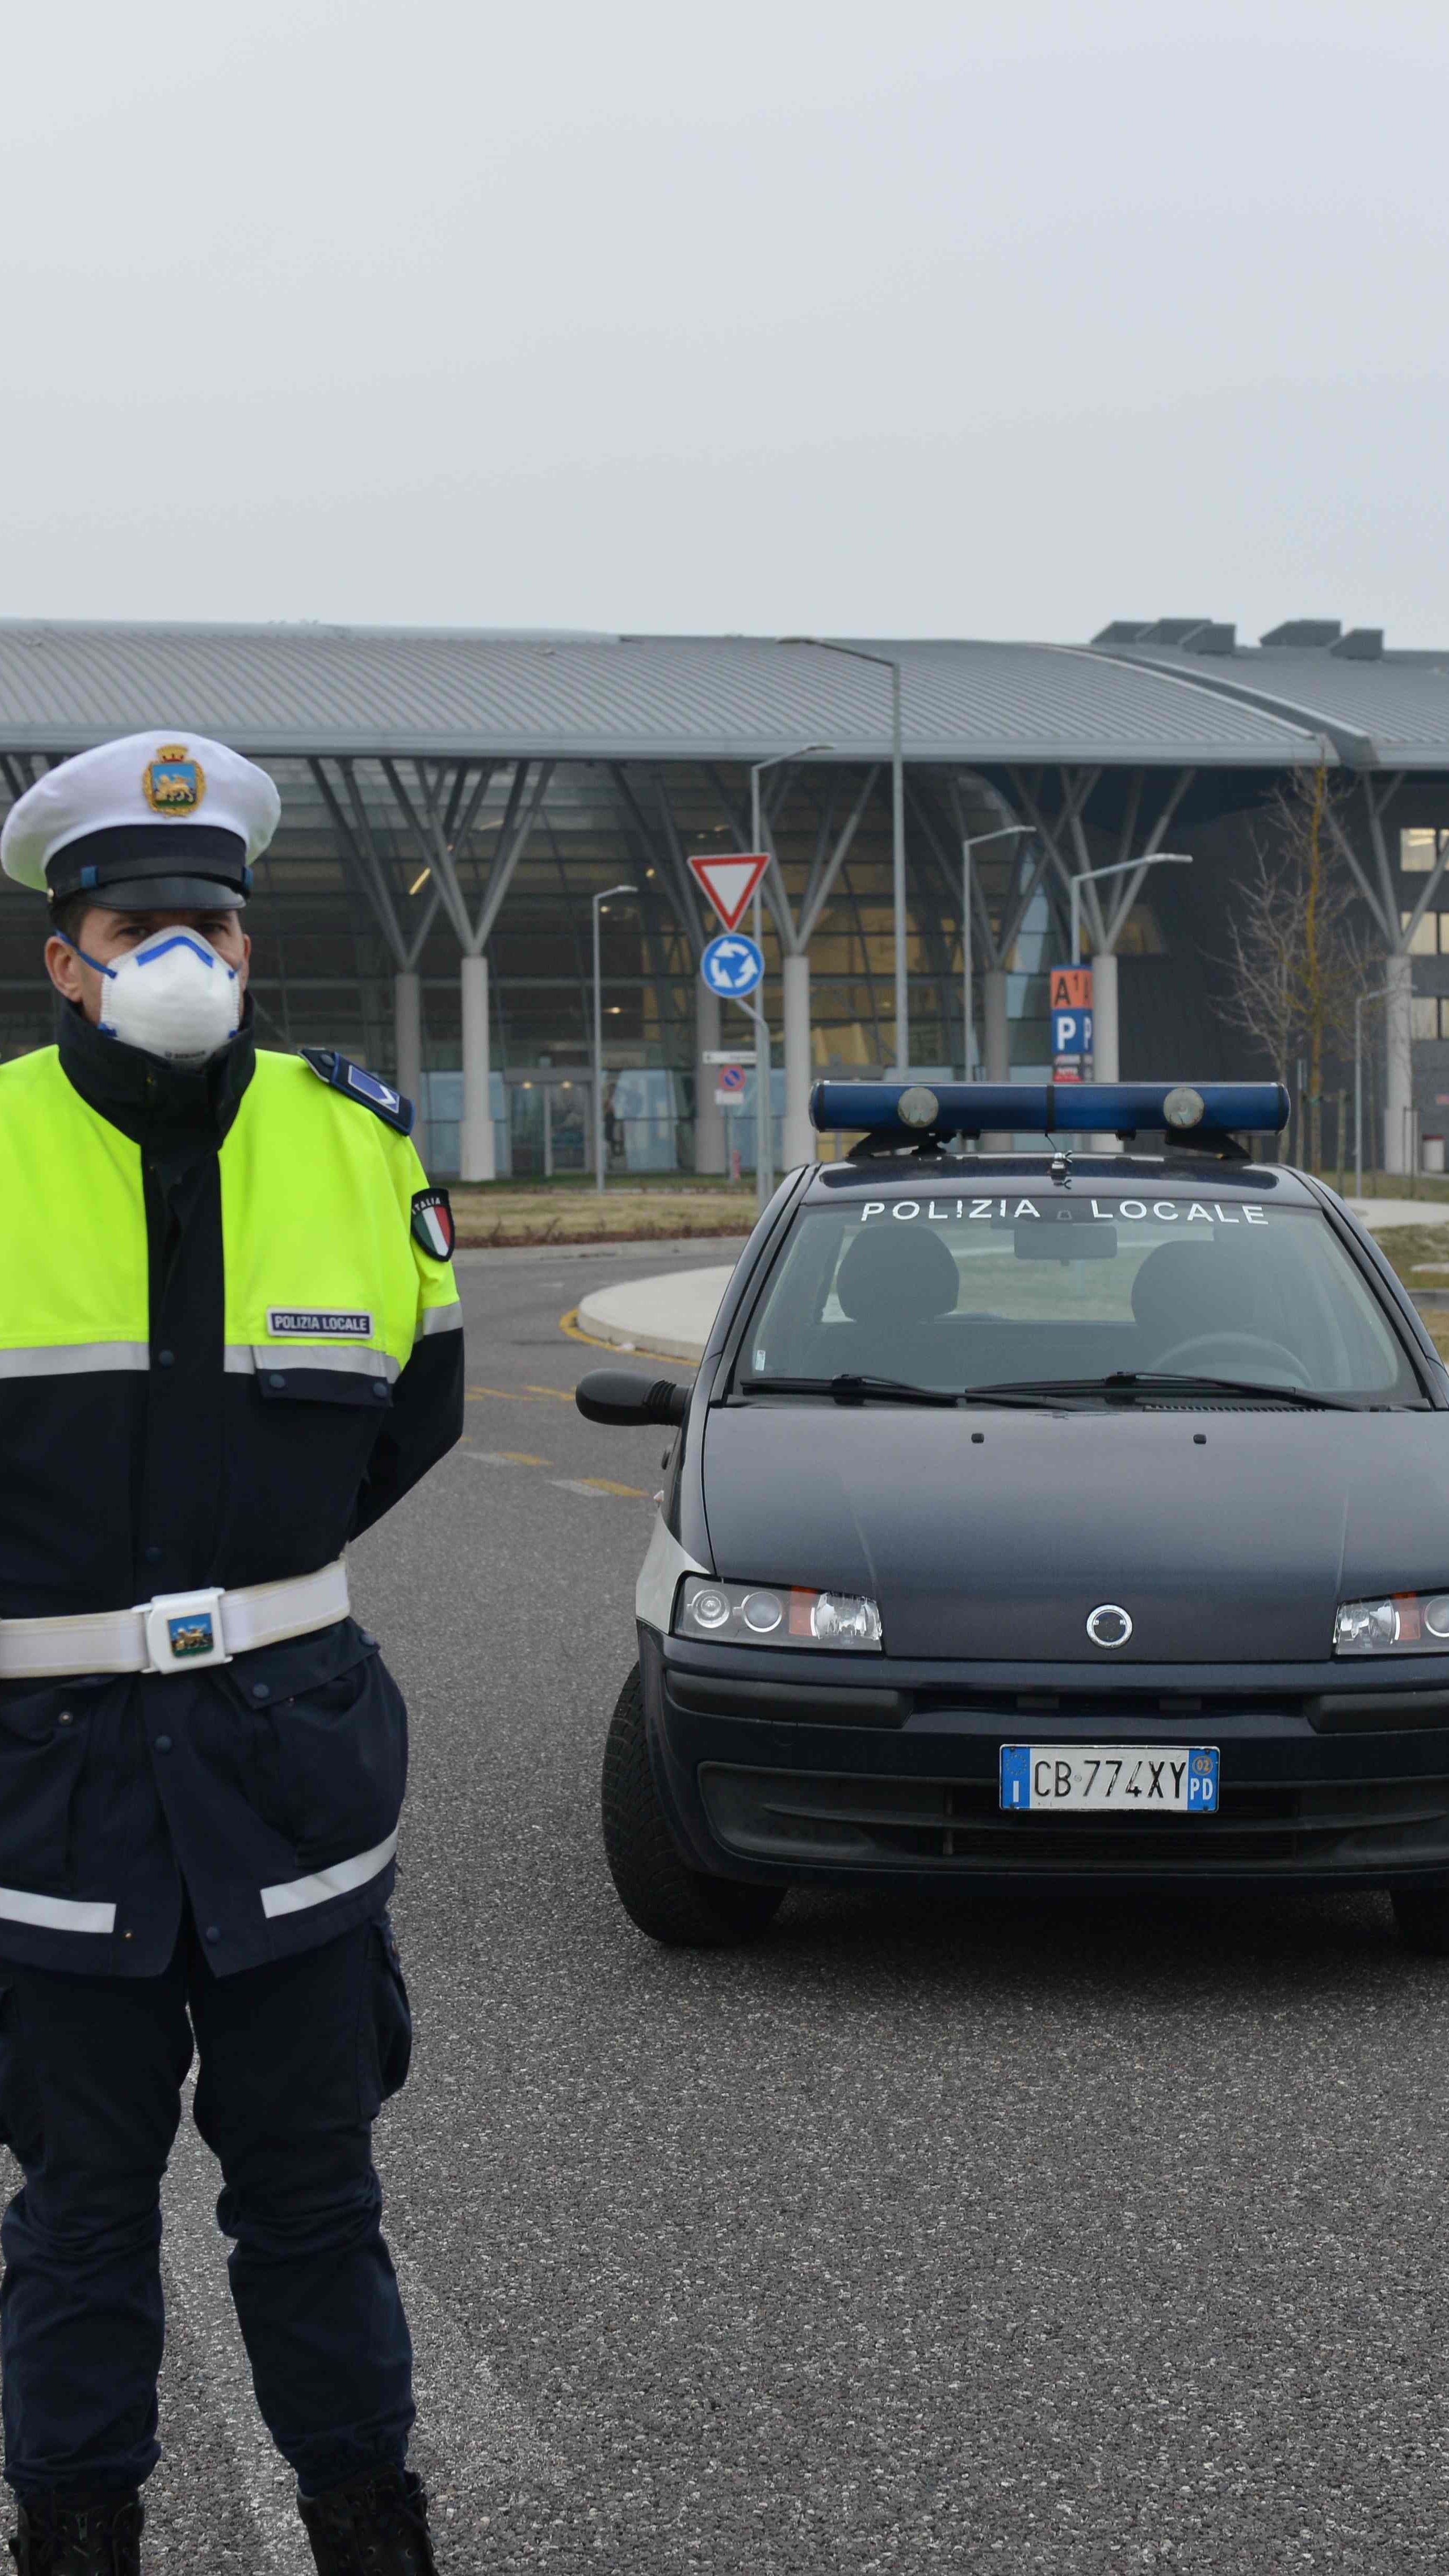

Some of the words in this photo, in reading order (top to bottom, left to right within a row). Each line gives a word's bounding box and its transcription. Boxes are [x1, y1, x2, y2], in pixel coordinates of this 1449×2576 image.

[1057, 1016, 1076, 1050] P
[412, 1197, 441, 1215] ITALIA
[861, 1199, 1040, 1221] POLIZIA
[1091, 1199, 1269, 1225] LOCALE
[274, 1315, 320, 1329] POLIZIA
[322, 1317, 367, 1331] LOCALE
[1190, 1778, 1213, 1800] PD
